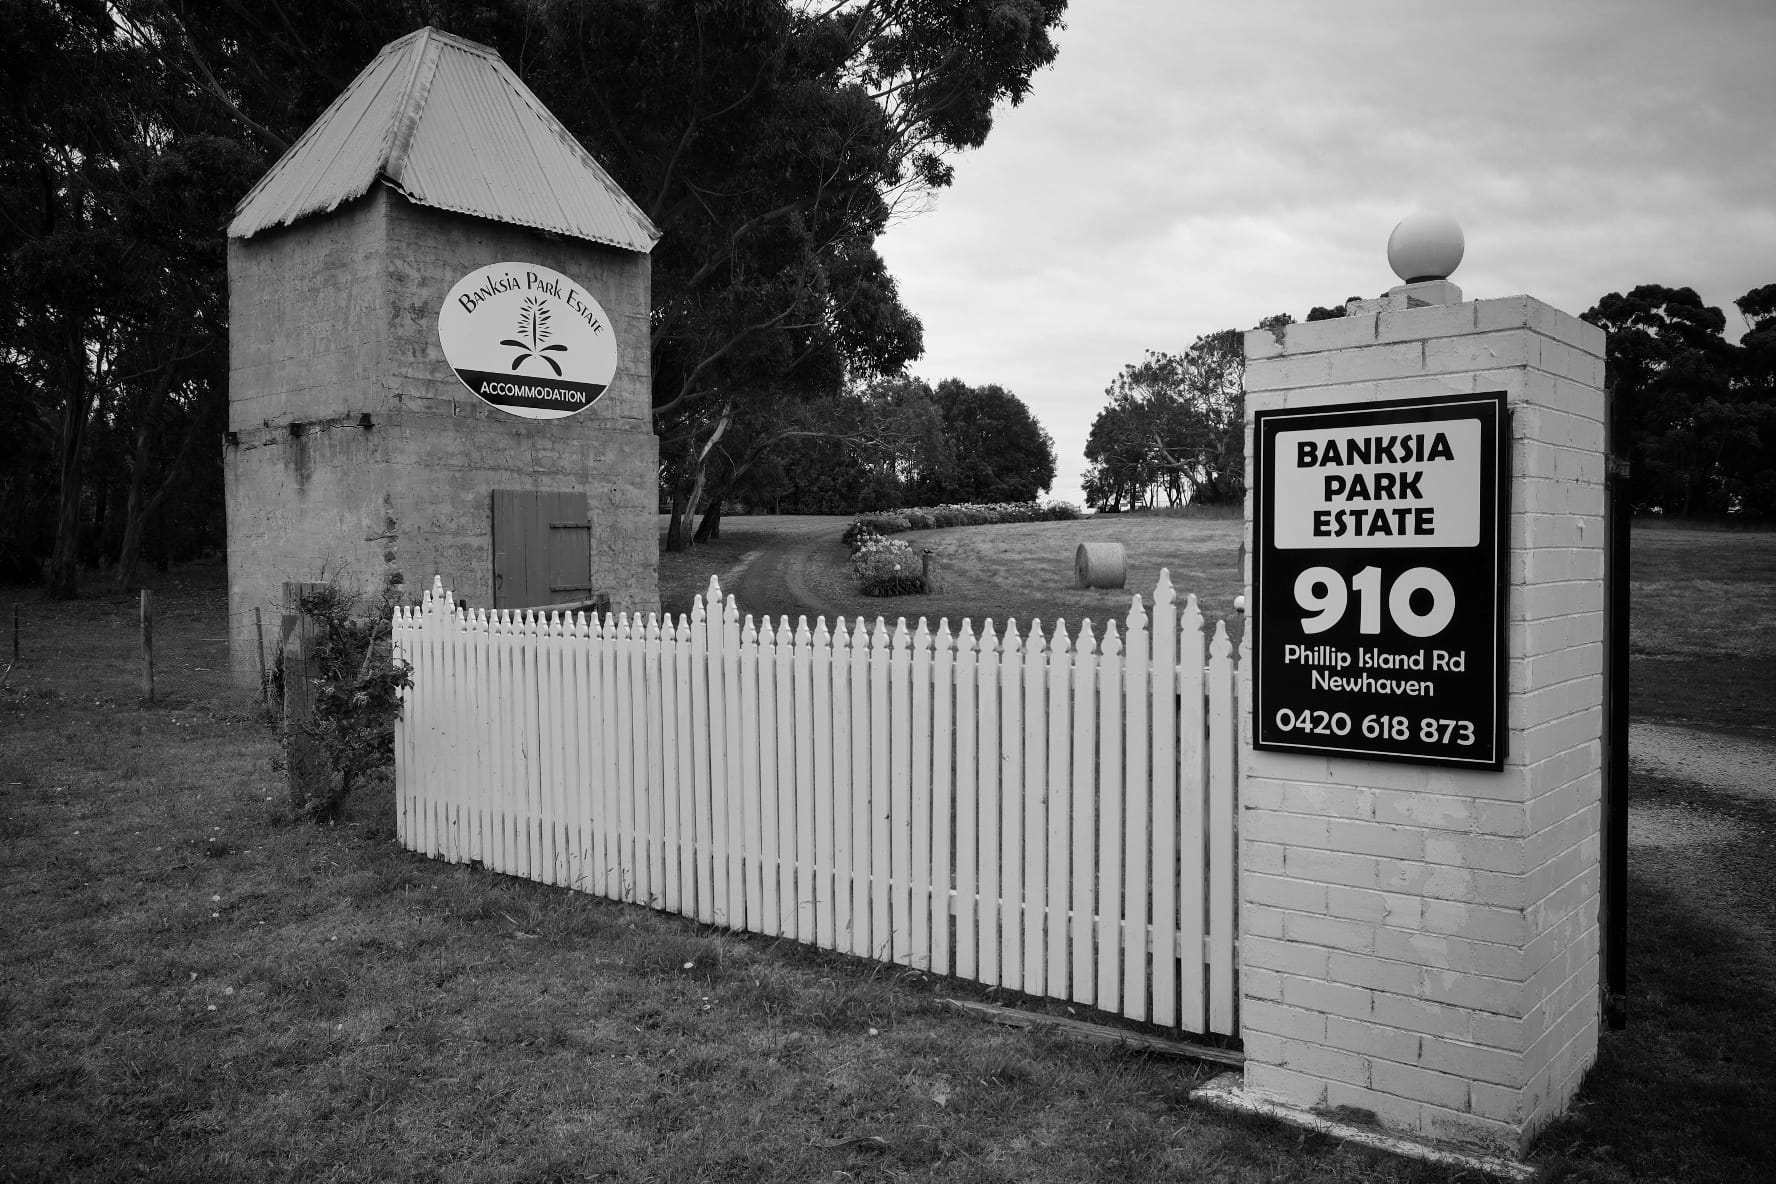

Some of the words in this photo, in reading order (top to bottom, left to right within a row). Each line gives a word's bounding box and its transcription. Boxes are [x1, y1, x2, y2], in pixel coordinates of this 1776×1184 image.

[480, 381, 586, 404] ACCOMMODATION
[1297, 432, 1455, 468] BANKSIA
[1324, 471, 1424, 502] PARK
[1313, 507, 1435, 537] ESTATE
[1293, 565, 1456, 638] 910
[1284, 644, 1351, 670] Phillip
[1358, 647, 1424, 671] Island
[1432, 650, 1466, 672] Rd
[1311, 669, 1434, 697] Newhaven
[1275, 708, 1352, 736] 0420
[1361, 714, 1410, 740] 618
[1419, 718, 1476, 746] 873
